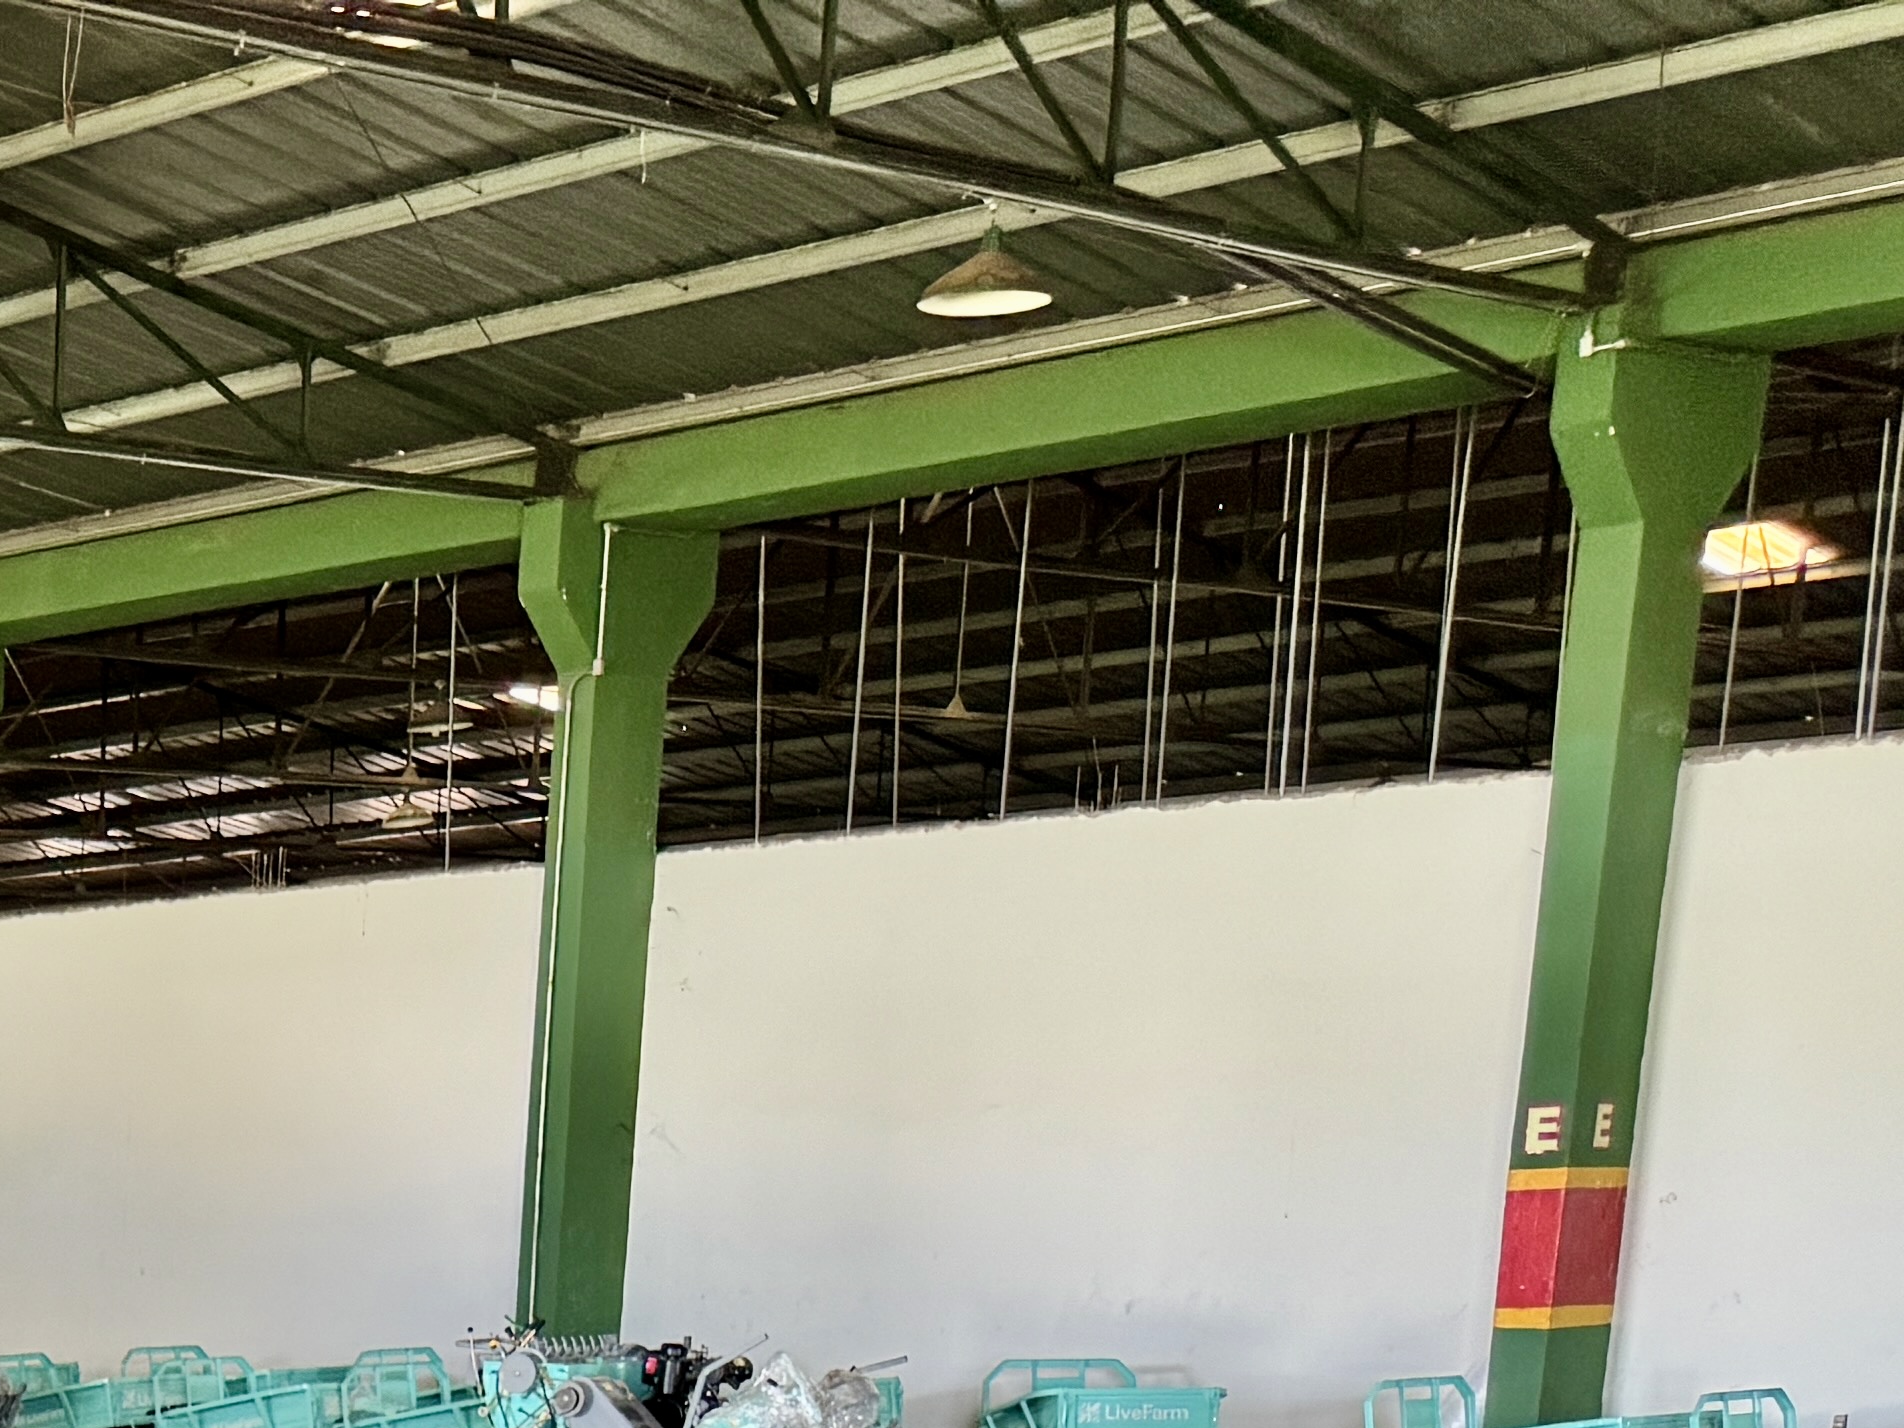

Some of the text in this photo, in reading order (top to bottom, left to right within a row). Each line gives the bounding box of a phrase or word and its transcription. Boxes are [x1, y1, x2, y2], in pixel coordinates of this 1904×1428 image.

[1525, 1106, 1561, 1154] E
[1593, 1103, 1614, 1148] E
[1103, 1403, 1191, 1421] LiveFarm
